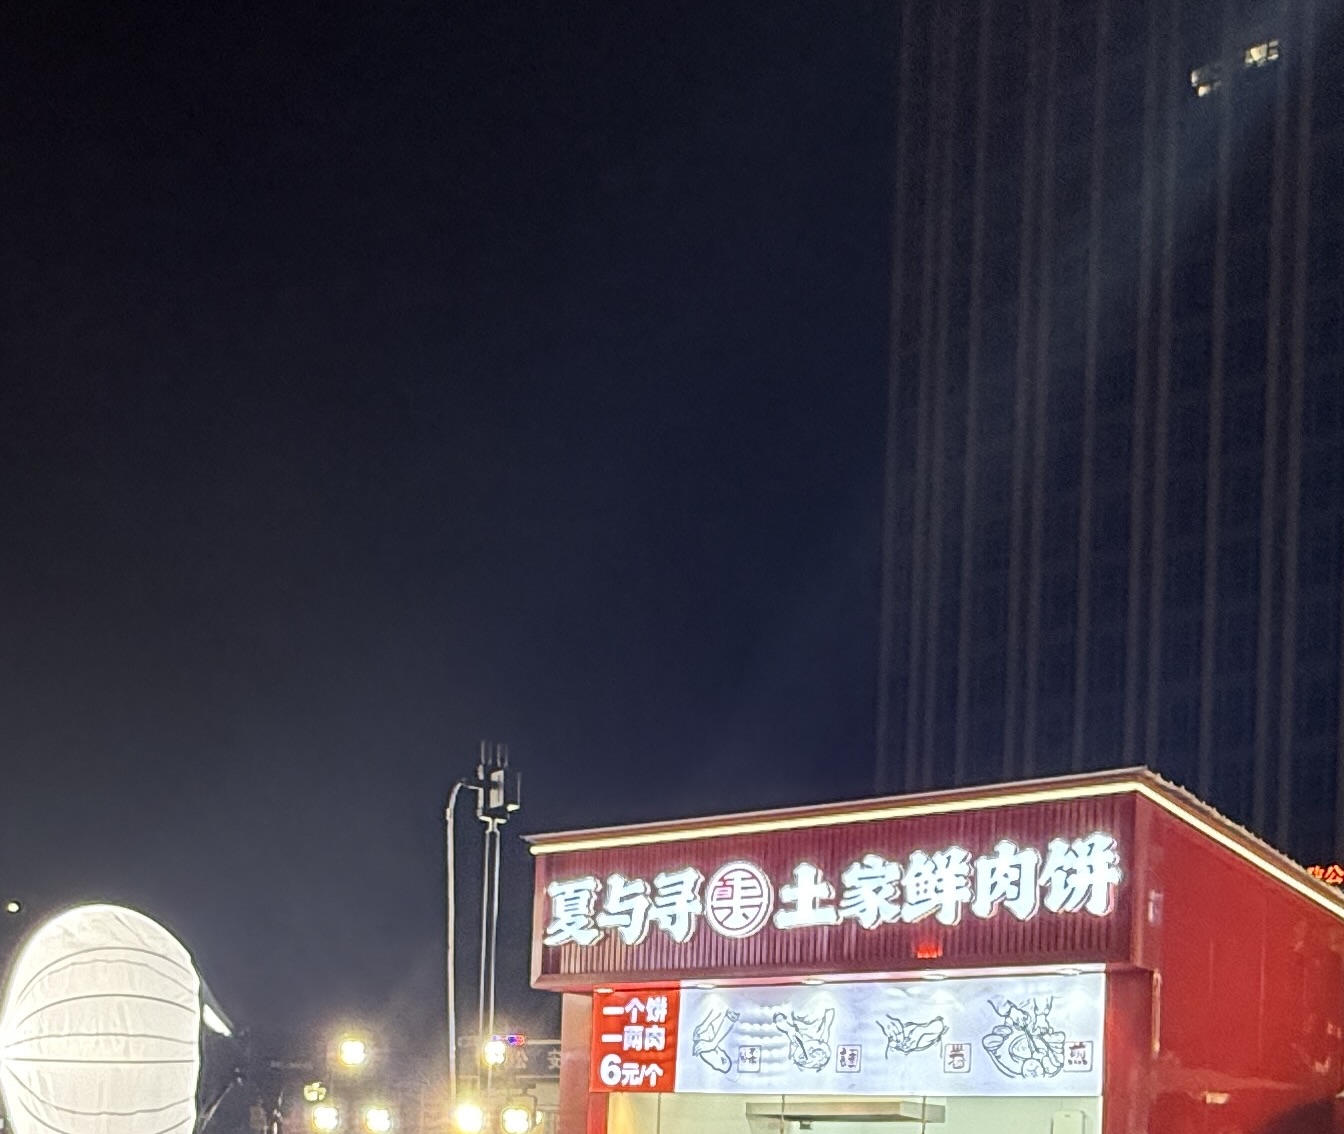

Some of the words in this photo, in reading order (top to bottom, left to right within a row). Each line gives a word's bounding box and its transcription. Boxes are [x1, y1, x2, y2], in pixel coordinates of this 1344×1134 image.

[544, 867, 704, 946] 夏与寻
[775, 832, 1121, 929] 土家鲜肉饼
[602, 997, 668, 1023] 一个饼
[601, 1026, 667, 1051] 一两肉
[600, 1054, 664, 1088] 6元/个
